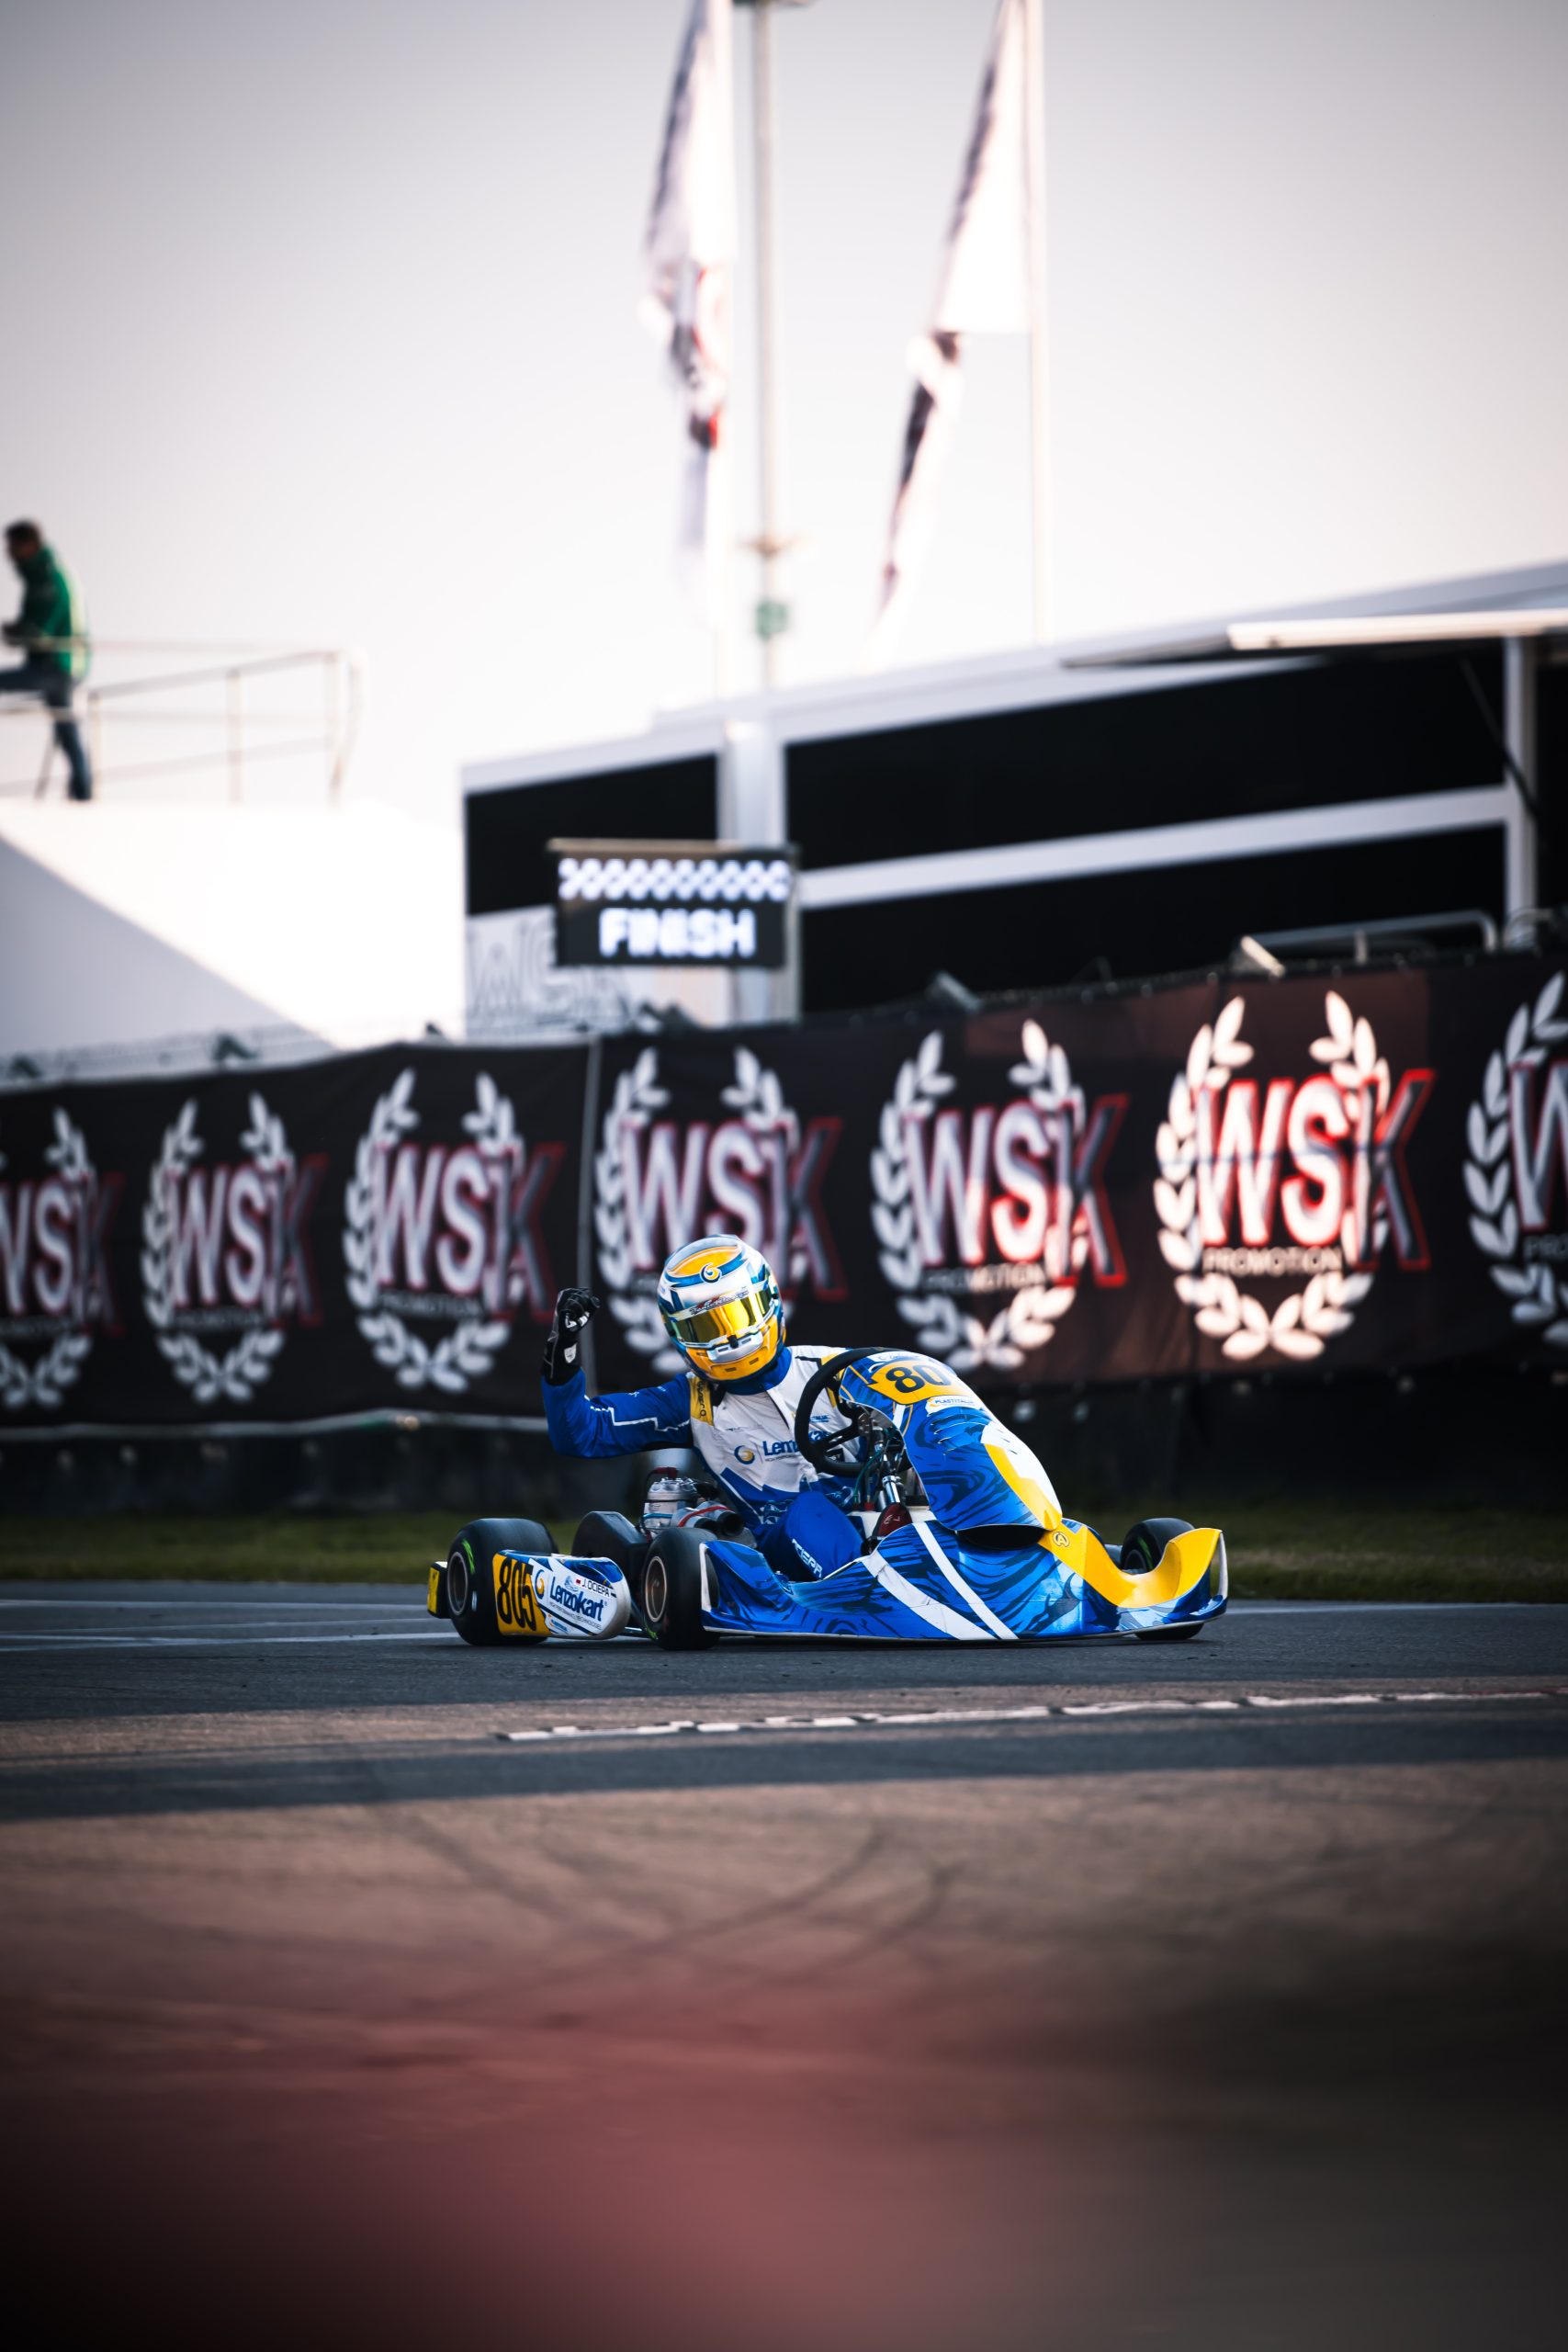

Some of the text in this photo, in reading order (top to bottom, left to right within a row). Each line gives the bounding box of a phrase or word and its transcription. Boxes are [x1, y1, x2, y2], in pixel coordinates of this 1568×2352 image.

[598, 907, 756, 959] FINISH
[619, 1115, 849, 1301] WSK
[904, 1092, 1128, 1286] WSK
[1192, 1068, 1437, 1271] WSK
[167, 1152, 329, 1326] WSK
[371, 1141, 566, 1323] WSK
[926, 1262, 1047, 1290] PROMOTION
[1201, 1246, 1344, 1276] PROMOTION
[497, 1557, 537, 1631] 805
[550, 1576, 604, 1622] Lenzokart
